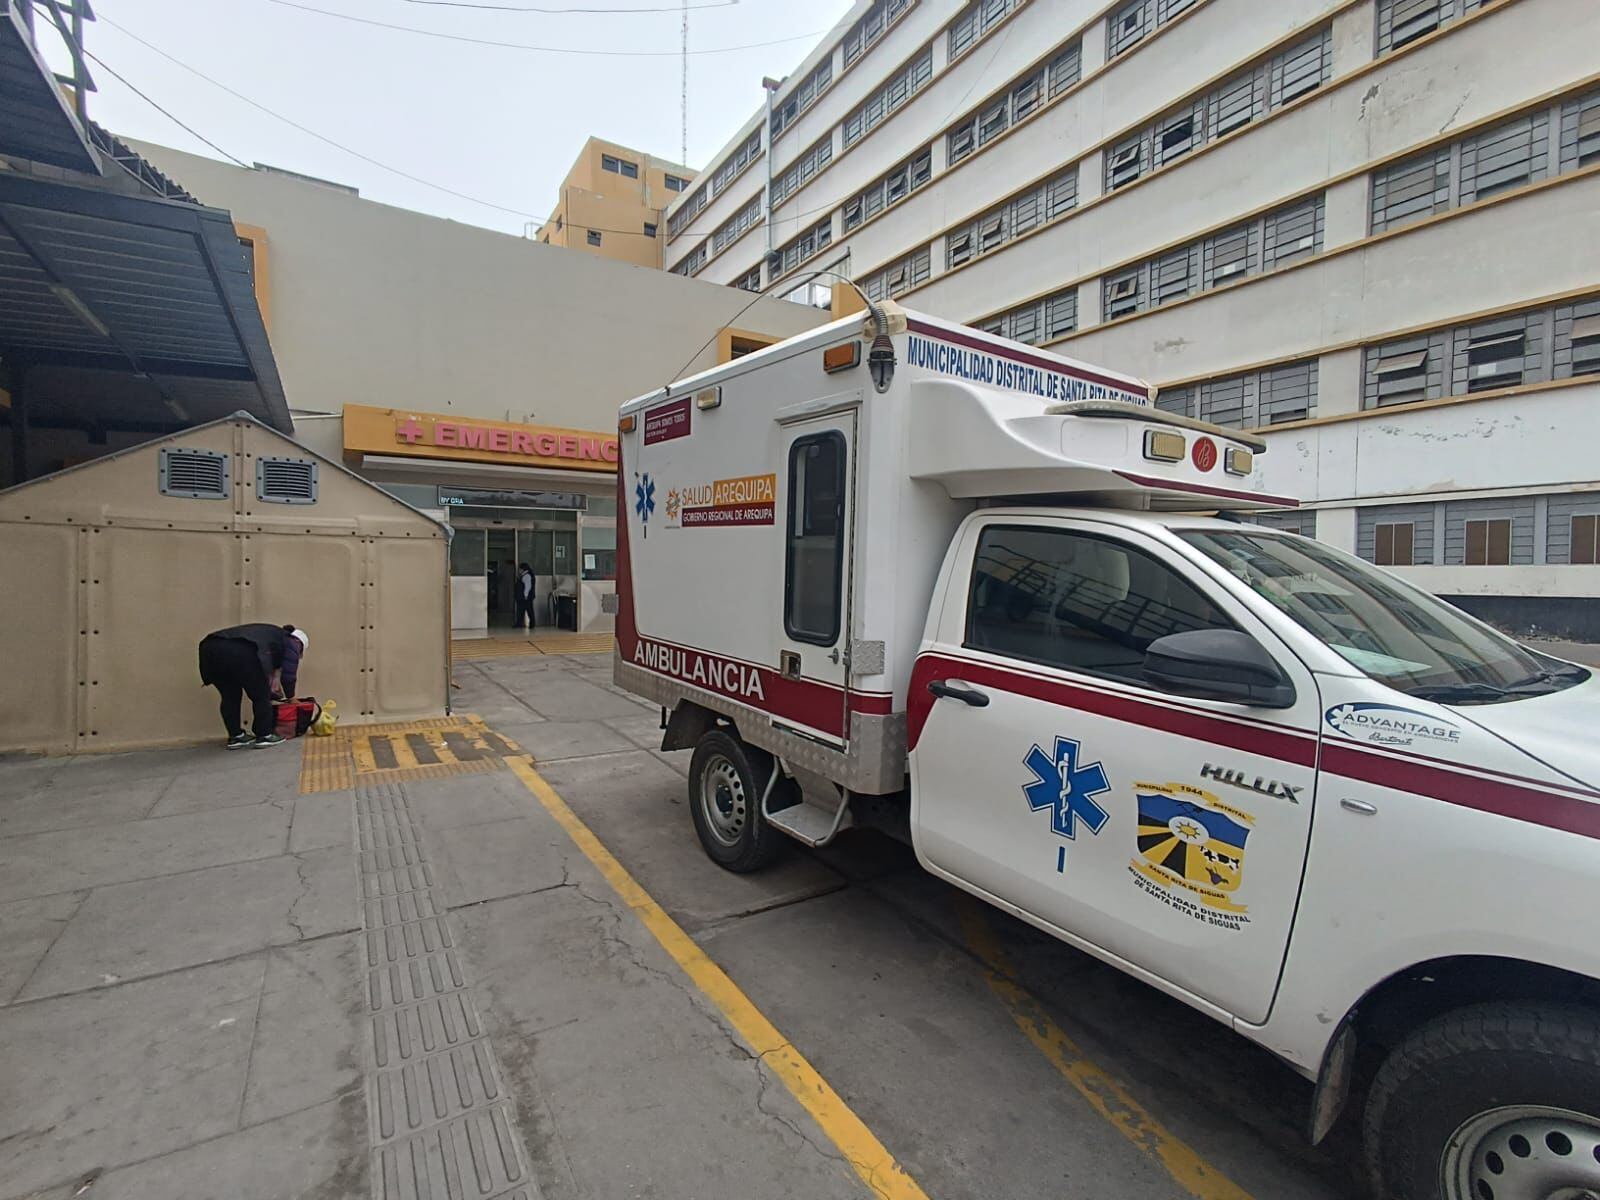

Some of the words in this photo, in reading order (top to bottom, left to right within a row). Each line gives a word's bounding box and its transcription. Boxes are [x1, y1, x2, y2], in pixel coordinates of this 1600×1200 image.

[907, 335, 994, 384] MUNICIPALIDAD
[996, 359, 1044, 397] DISTRITAL
[1046, 372, 1059, 399] DE
[1060, 377, 1087, 401] SANTA
[682, 486, 713, 505] SALUD
[714, 478, 774, 504] AREQUIPA
[682, 512, 708, 523] GOBIERNO
[708, 509, 734, 521] REGIONAL
[734, 509, 743, 520] DE
[743, 507, 773, 520] AREQUIPA
[634, 640, 765, 701] AMBULANCIA
[1343, 713, 1461, 740] ADVANTAGE
[1200, 762, 1304, 804] HILUX
[1181, 785, 1203, 796] 1944
[1213, 802, 1247, 820] DISTRITAL
[1128, 865, 1197, 911] MUNICIPALIDAD
[1200, 907, 1251, 923] DISTRITAL
[1149, 864, 1169, 879] SANTA
[1171, 877, 1187, 888] RITA
[1199, 889, 1226, 899] SIGUAS
[1134, 879, 1144, 889] DE
[1145, 886, 1171, 906] SANTA
[1172, 901, 1193, 916] RITA
[1194, 912, 1207, 922] DE
[1208, 917, 1241, 931] SIGUAS
